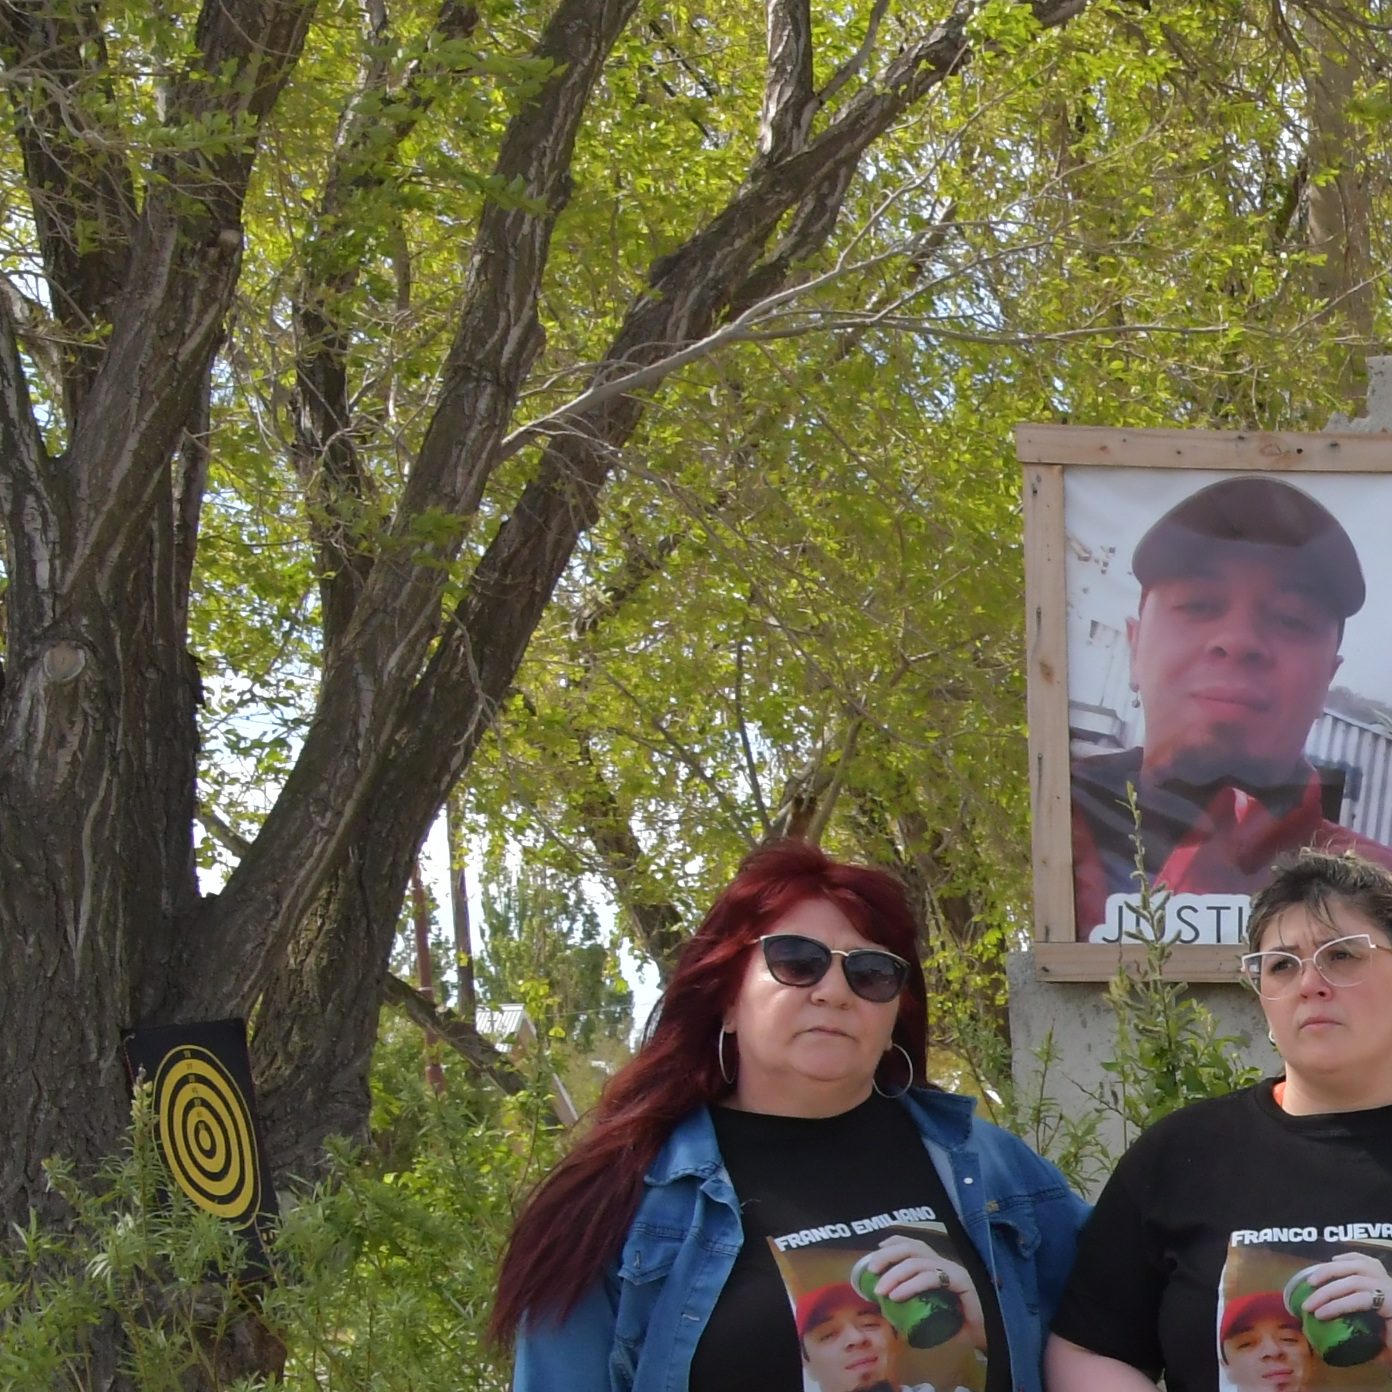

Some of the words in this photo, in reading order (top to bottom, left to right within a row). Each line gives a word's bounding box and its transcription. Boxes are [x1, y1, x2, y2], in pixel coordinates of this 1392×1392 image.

[775, 1222, 851, 1252] FRANCO
[850, 1205, 936, 1236] EMILIANO
[1231, 1226, 1318, 1248] FRANCO
